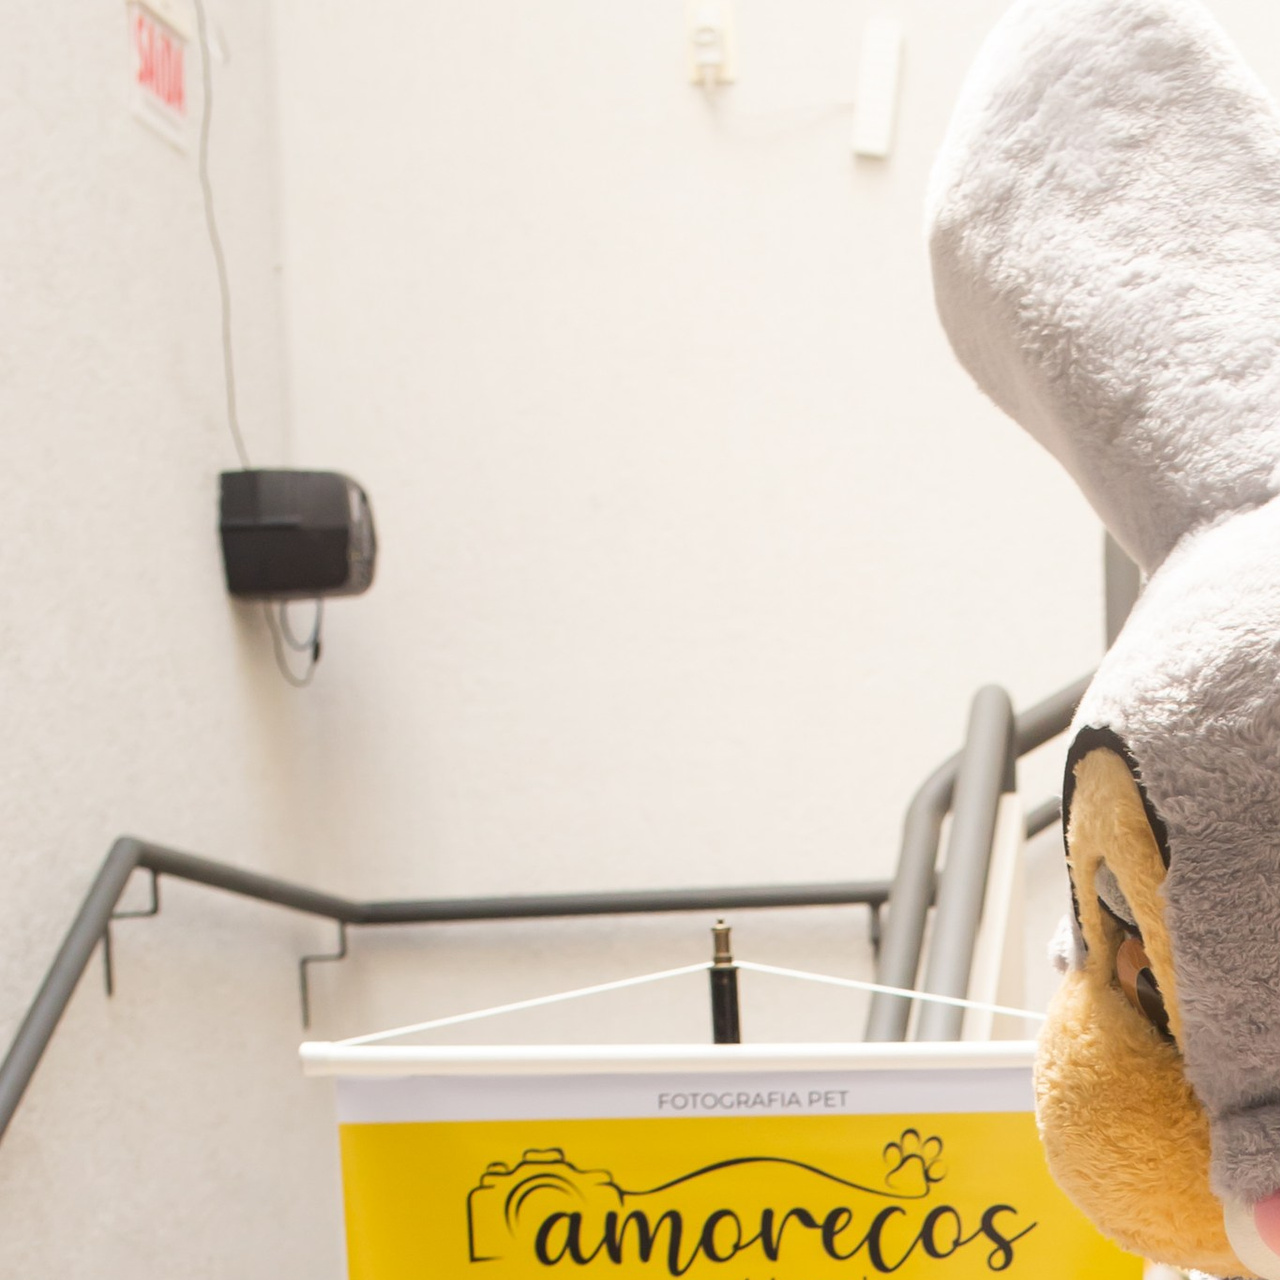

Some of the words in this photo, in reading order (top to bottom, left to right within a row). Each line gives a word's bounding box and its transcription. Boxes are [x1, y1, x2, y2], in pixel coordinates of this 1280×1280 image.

[657, 1091, 803, 1111] FOTOGRAFIA
[807, 1090, 849, 1108] PET
[534, 1204, 1038, 1277] amorecos
